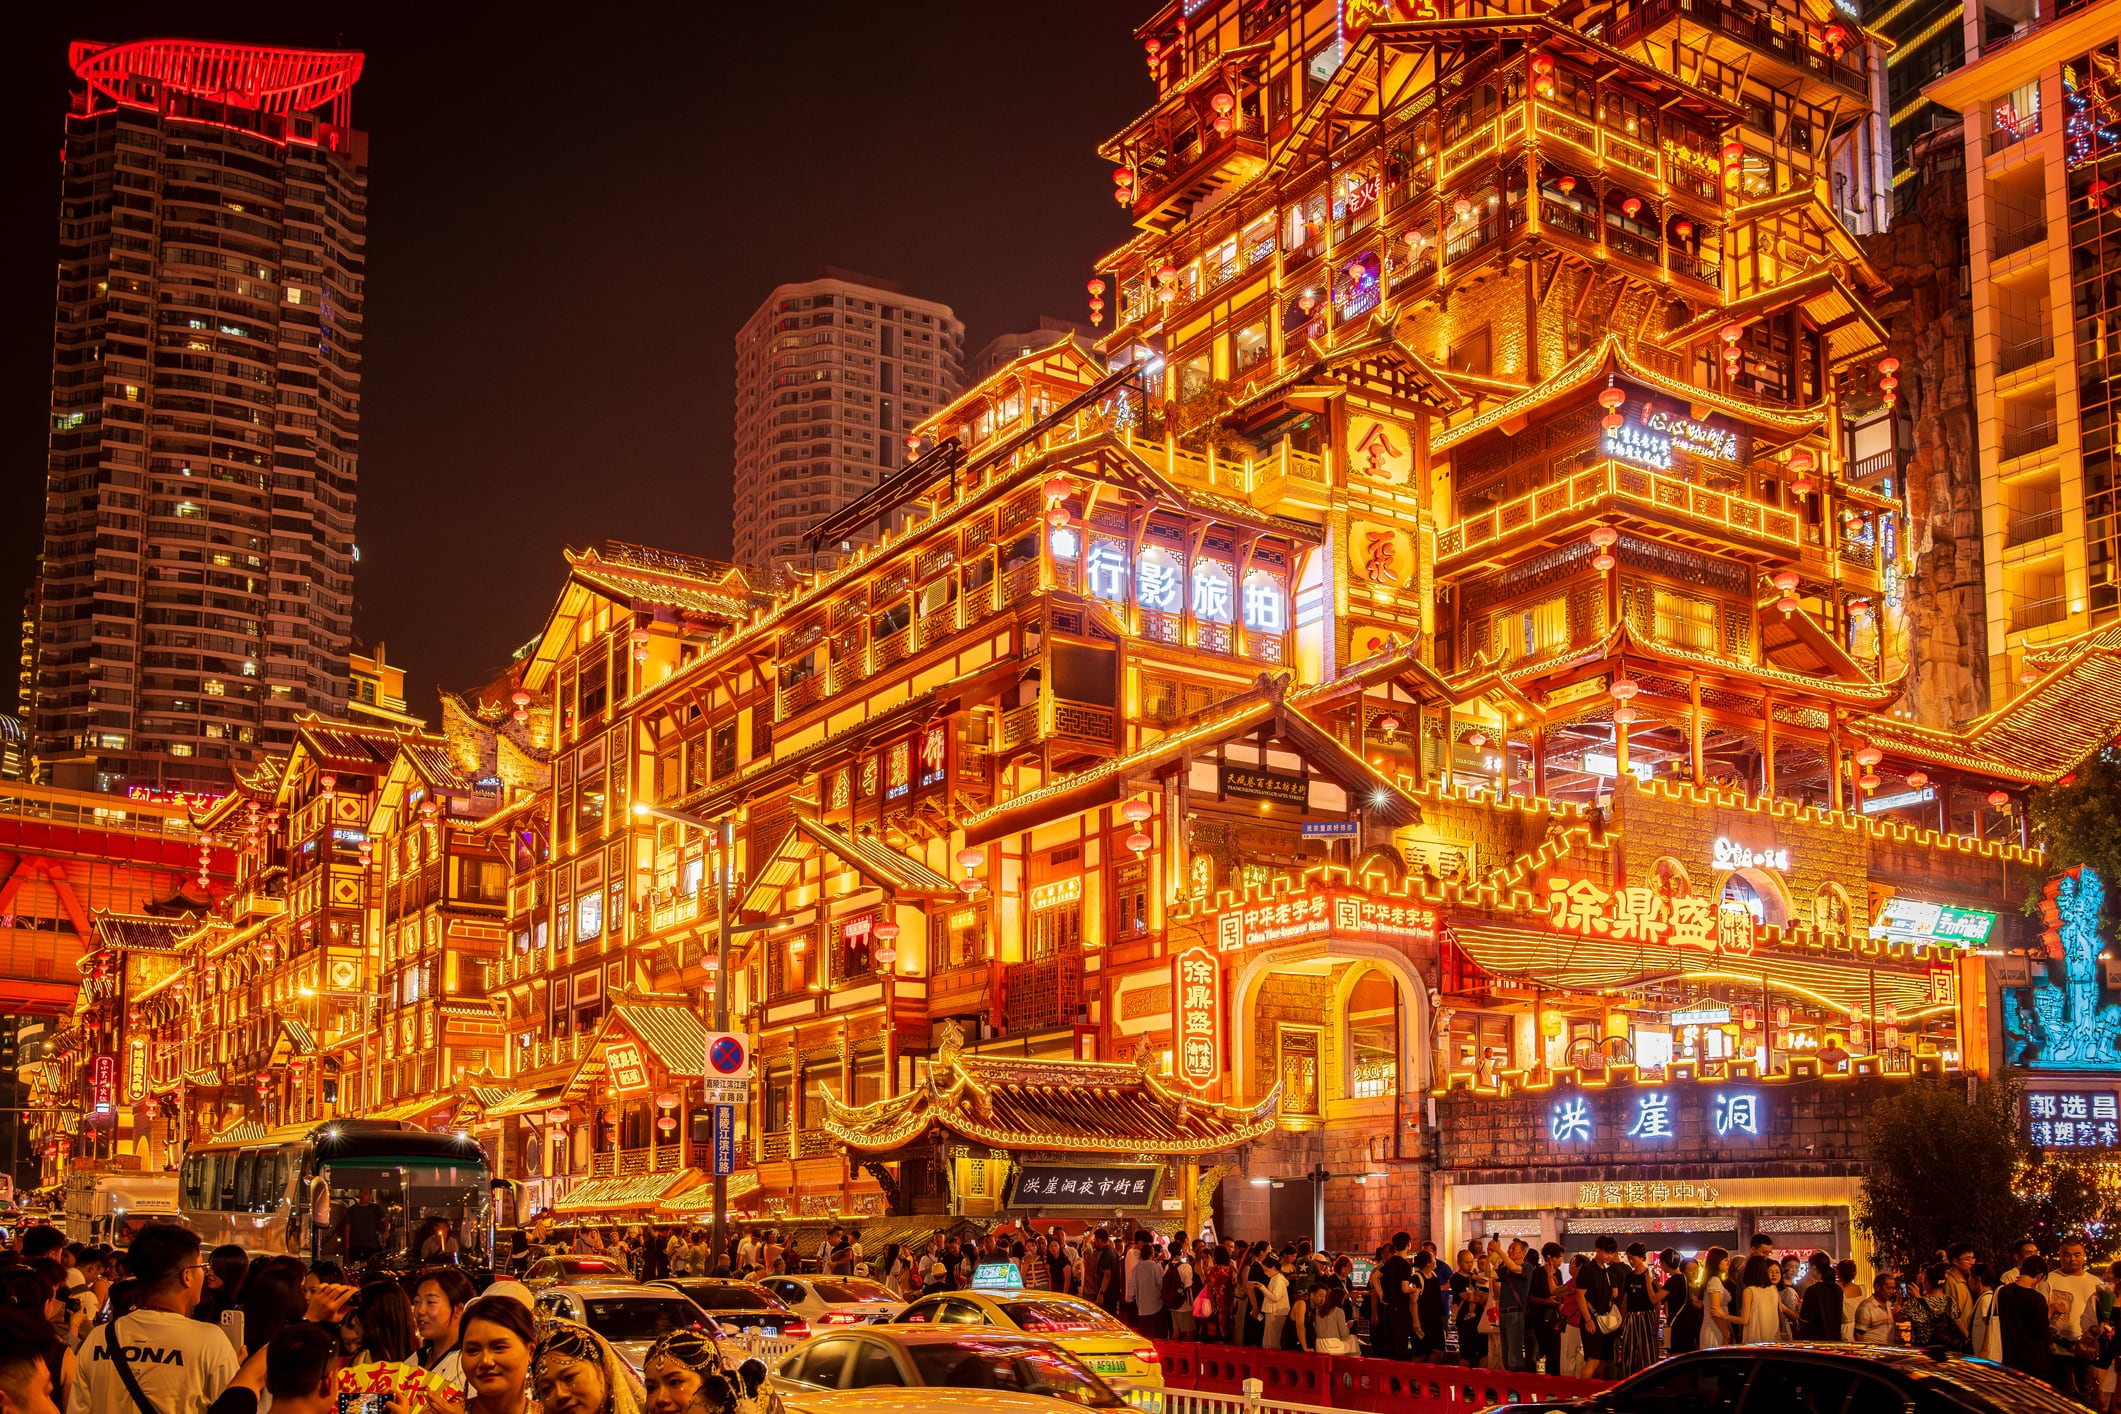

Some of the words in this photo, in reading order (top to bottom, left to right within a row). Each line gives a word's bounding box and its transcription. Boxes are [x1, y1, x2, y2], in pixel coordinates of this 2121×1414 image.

[1088, 548, 1280, 629] 行影旅拍
[1245, 896, 1326, 930] 中华老字号
[1362, 903, 1436, 928] 中华老字号
[1549, 878, 1718, 951] 徐鼎盛
[1183, 960, 1213, 1035] 徐鼎盛
[706, 1079, 747, 1090] 嘉陵江滨江路
[1552, 1093, 1758, 1141] 洪崖洞
[2029, 1095, 2118, 1120] 郭选昌
[718, 1107, 731, 1174] 嘉陵江滨江路
[2030, 1121, 2119, 1147] 雕塑艺术
[1023, 1176, 1147, 1197] 洪崖洞夜市街區
[1579, 1181, 1719, 1205] 游客接待中心
